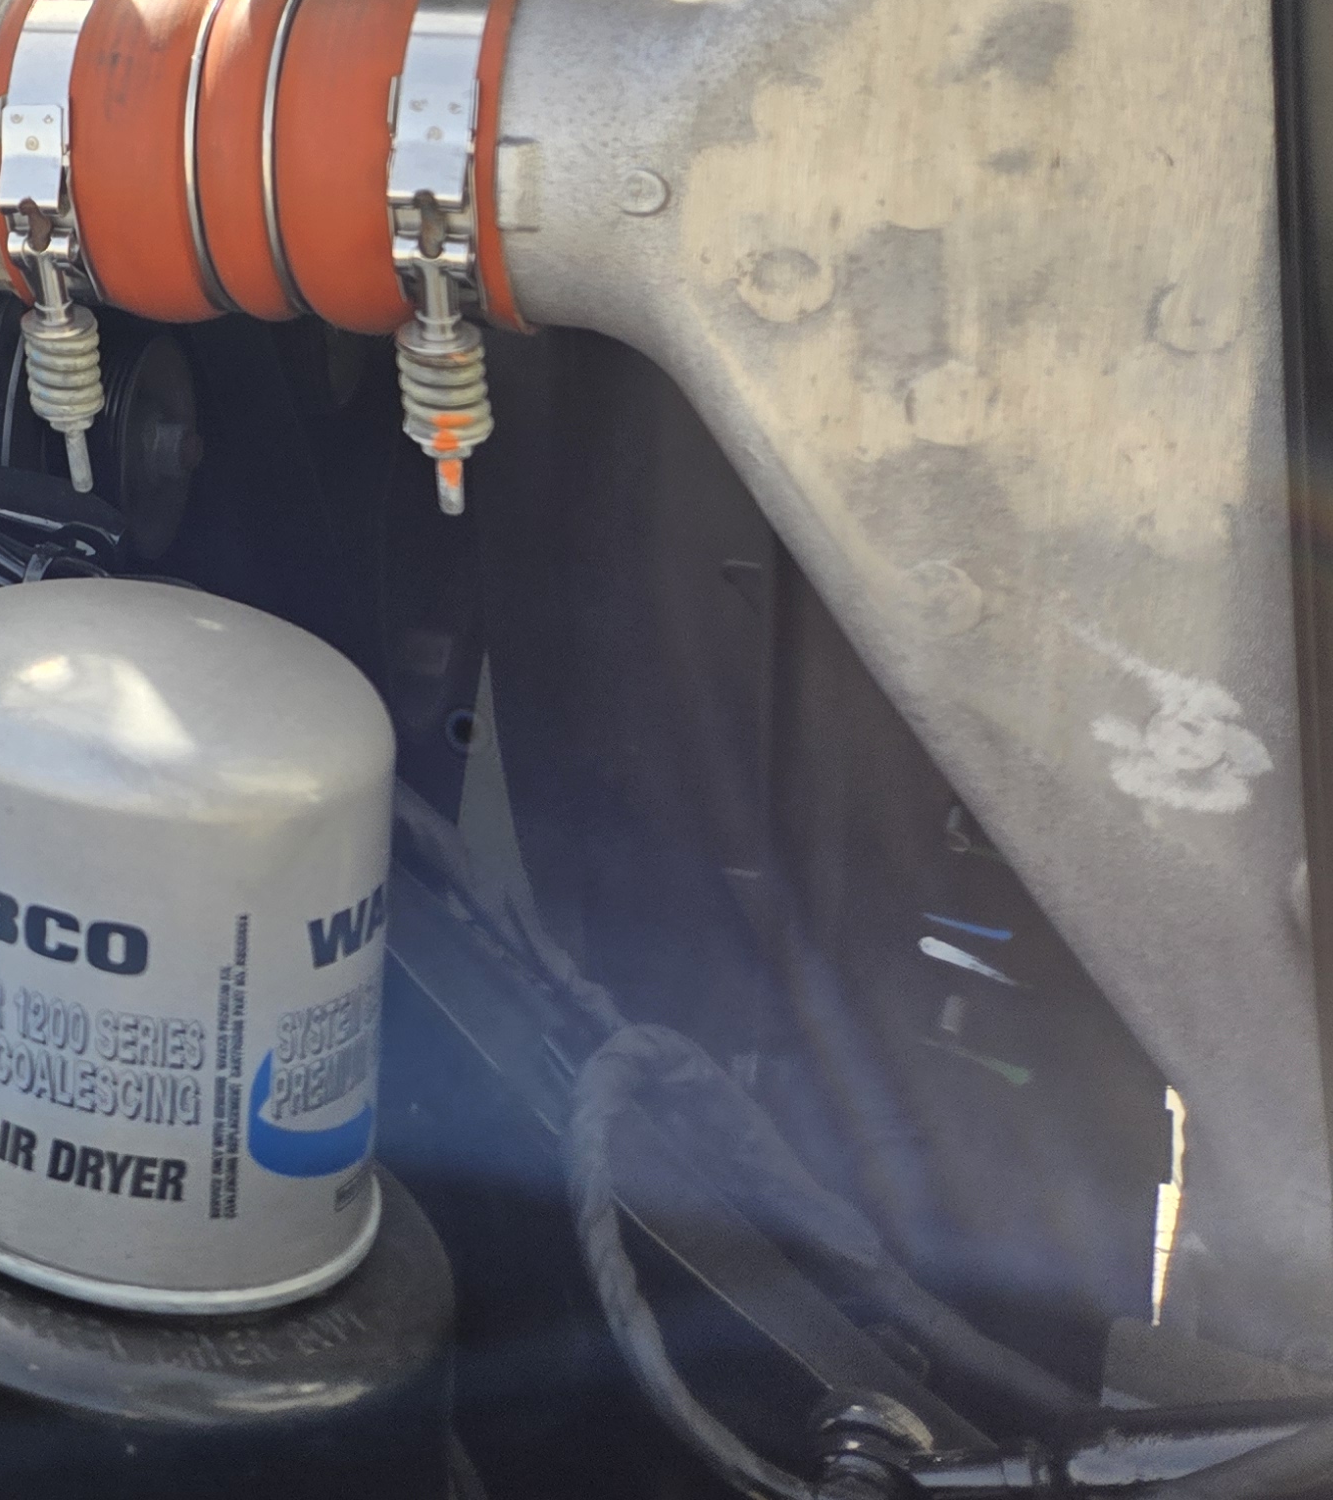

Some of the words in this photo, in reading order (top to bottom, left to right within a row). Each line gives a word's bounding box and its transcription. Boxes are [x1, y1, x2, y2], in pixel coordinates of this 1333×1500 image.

[13, 985, 90, 1055] 1200
[95, 1008, 206, 1071] SERIES
[46, 1137, 188, 1202] DRYER
